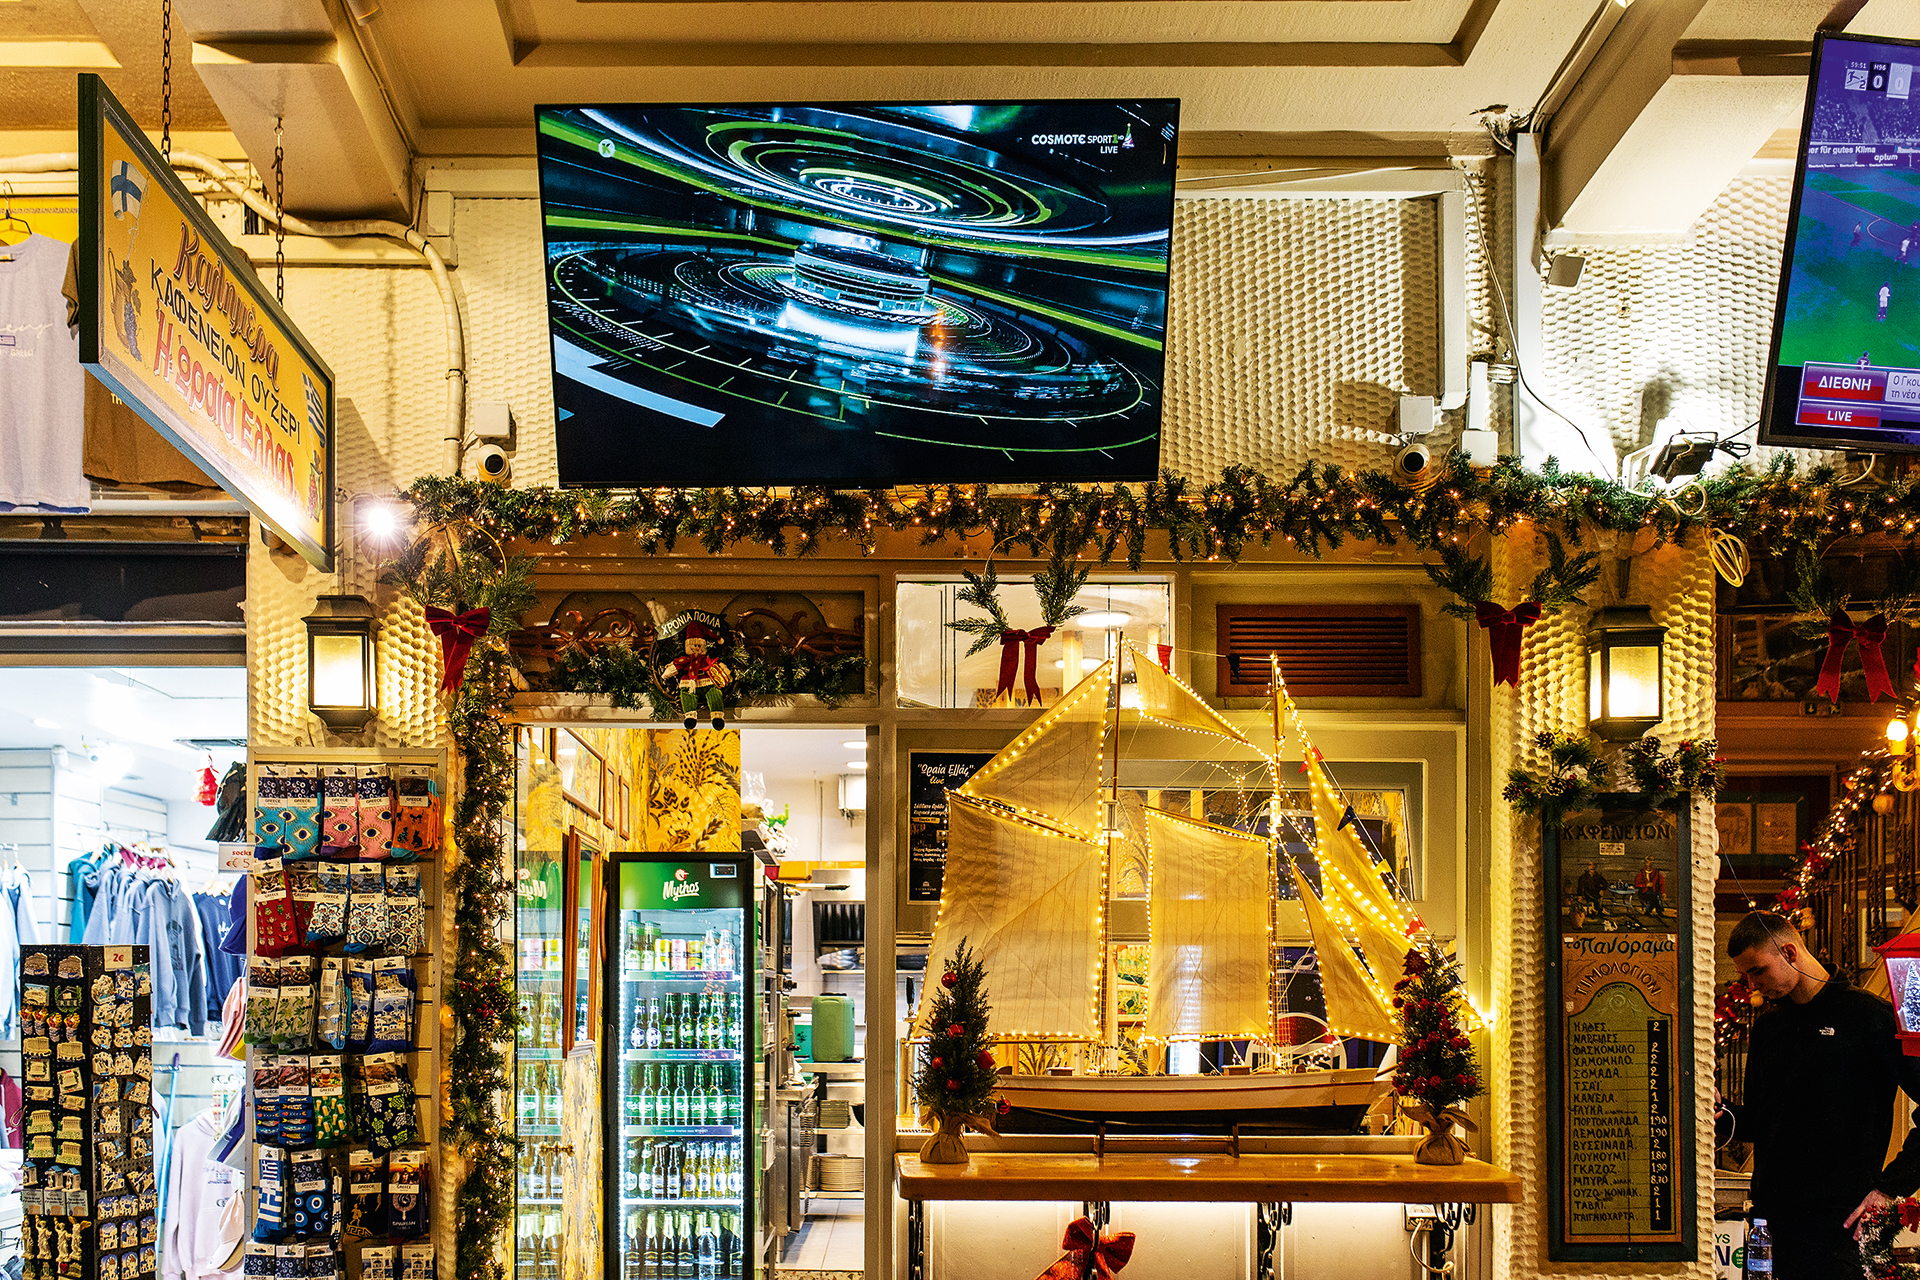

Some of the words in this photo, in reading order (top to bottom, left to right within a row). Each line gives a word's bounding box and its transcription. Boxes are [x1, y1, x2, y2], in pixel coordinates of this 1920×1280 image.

[1873, 75, 1883, 89] 0
[1031, 134, 1086, 145] COSMOTE
[1100, 146, 1118, 154] LIVE
[1855, 146, 1876, 154] Klima
[150, 257, 246, 388] ΚΑΦΕΝΕΙΟΝ
[251, 373, 301, 446] ΟΥΖΕΡΙ
[1818, 376, 1872, 391] ΔΙΕΘΝΗ
[1891, 389, 1900, 398] τη
[1902, 389, 1916, 400] νέα
[1827, 410, 1853, 422] LIVE
[661, 612, 693, 636] ΧΡΟΝΙΑ
[693, 611, 721, 628] ΠΟΛΛΑ
[1563, 824, 1673, 841] ΚΑΦΕΝΕΙΟΝ
[243, 858, 250, 868] 5
[662, 880, 700, 902] Mythos
[1580, 935, 1675, 959] Πανόραμα
[113, 953, 124, 963] 2€
[1574, 961, 1662, 997] ΤΙΜΟΛΟΓΙΟΝ
[1653, 1021, 1661, 1031] 2
[1651, 1042, 1660, 1052] 2
[1651, 1054, 1659, 1064] 2
[1650, 1066, 1659, 1076] 2
[1650, 1079, 1658, 1090] 2
[1651, 1104, 1659, 1114] 2
[1653, 1139, 1661, 1149] 2
[1653, 1186, 1661, 1196] 2
[1655, 1198, 1661, 1208] 1
[1655, 1210, 1661, 1221] 1
